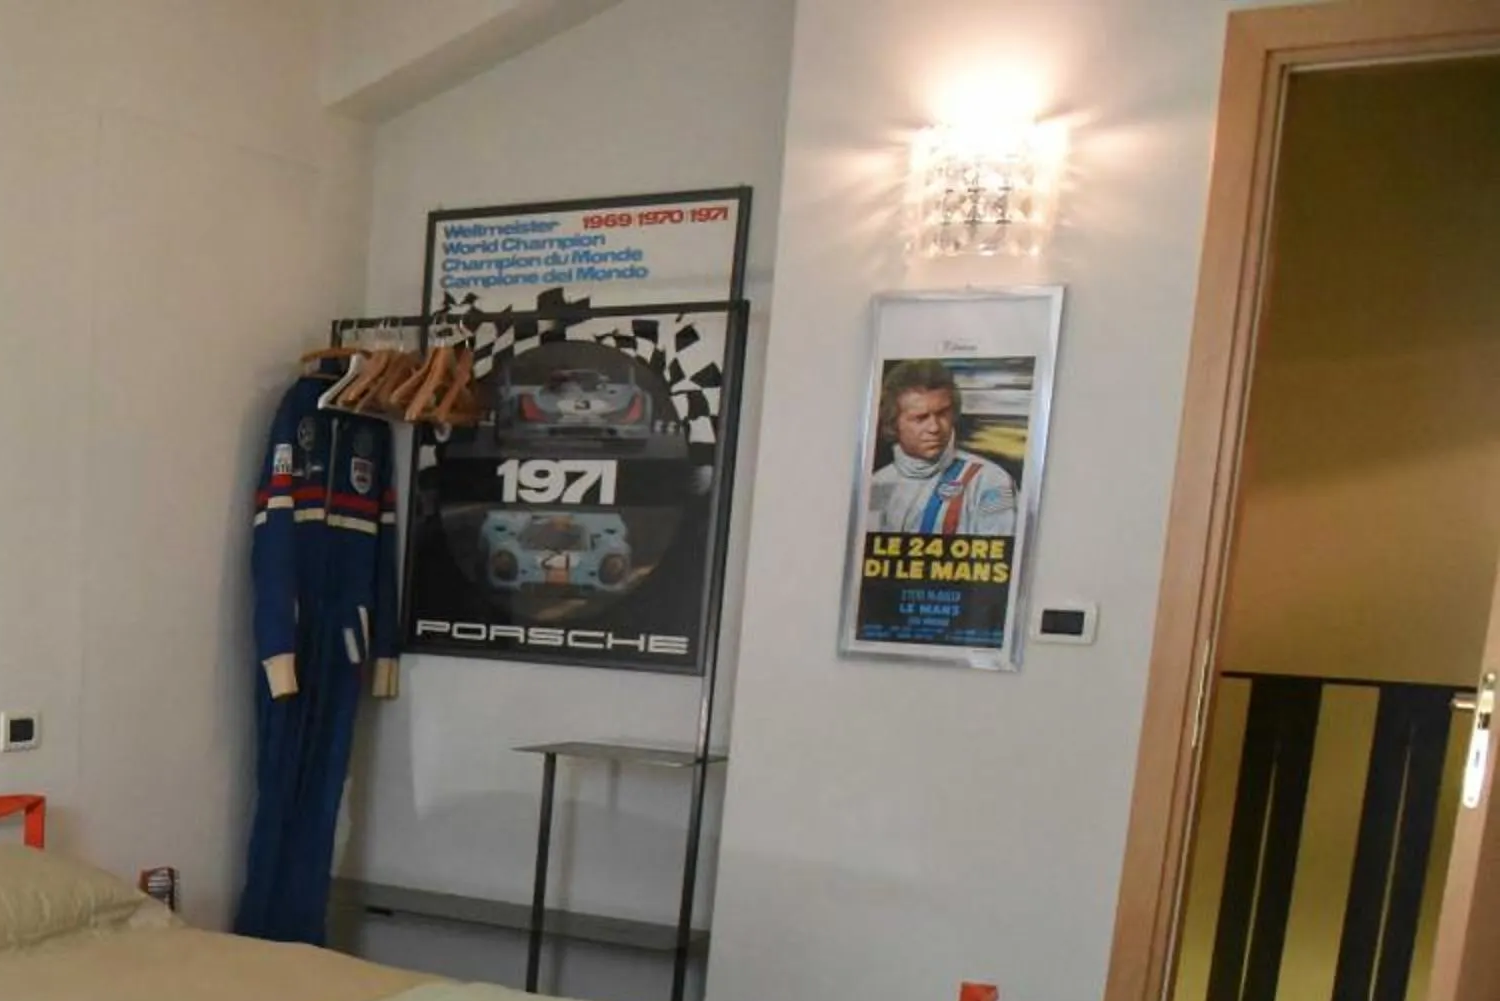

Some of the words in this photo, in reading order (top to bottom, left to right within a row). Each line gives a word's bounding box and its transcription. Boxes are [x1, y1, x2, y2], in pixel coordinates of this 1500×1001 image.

[444, 219, 560, 239] Weltmeister
[583, 213, 632, 230] 1969
[638, 210, 684, 226] 1970
[690, 207, 728, 222] 1971
[442, 239, 499, 255] World
[502, 233, 606, 251] Champion
[442, 254, 541, 274] Champion
[544, 252, 569, 267] du
[572, 247, 643, 265] Monde
[441, 271, 540, 290] Campione
[543, 269, 572, 284] del
[576, 265, 649, 282] Mondo
[496, 458, 618, 505] 1971
[873, 535, 903, 556] LE
[908, 536, 943, 558] 24
[950, 538, 1005, 560] ORE
[864, 557, 889, 578] DI
[895, 558, 924, 579] LE
[930, 559, 1011, 584] MANS
[416, 619, 690, 655] PORSCHE
